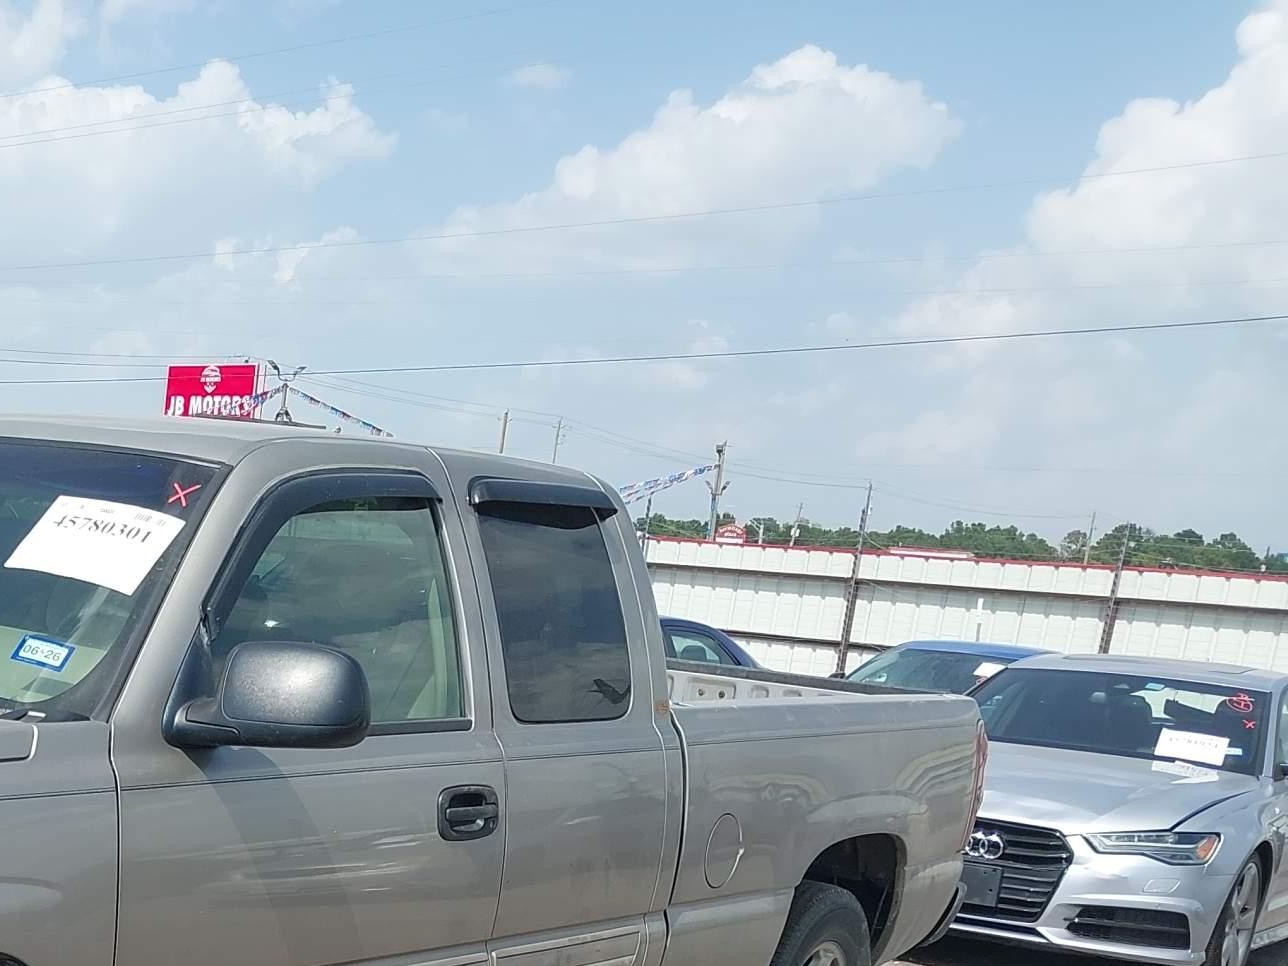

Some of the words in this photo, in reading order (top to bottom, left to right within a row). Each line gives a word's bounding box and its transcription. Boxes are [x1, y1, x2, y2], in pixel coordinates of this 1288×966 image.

[167, 395, 185, 416] JB
[188, 395, 252, 417] MOTORS
[52, 514, 153, 544] 45780301
